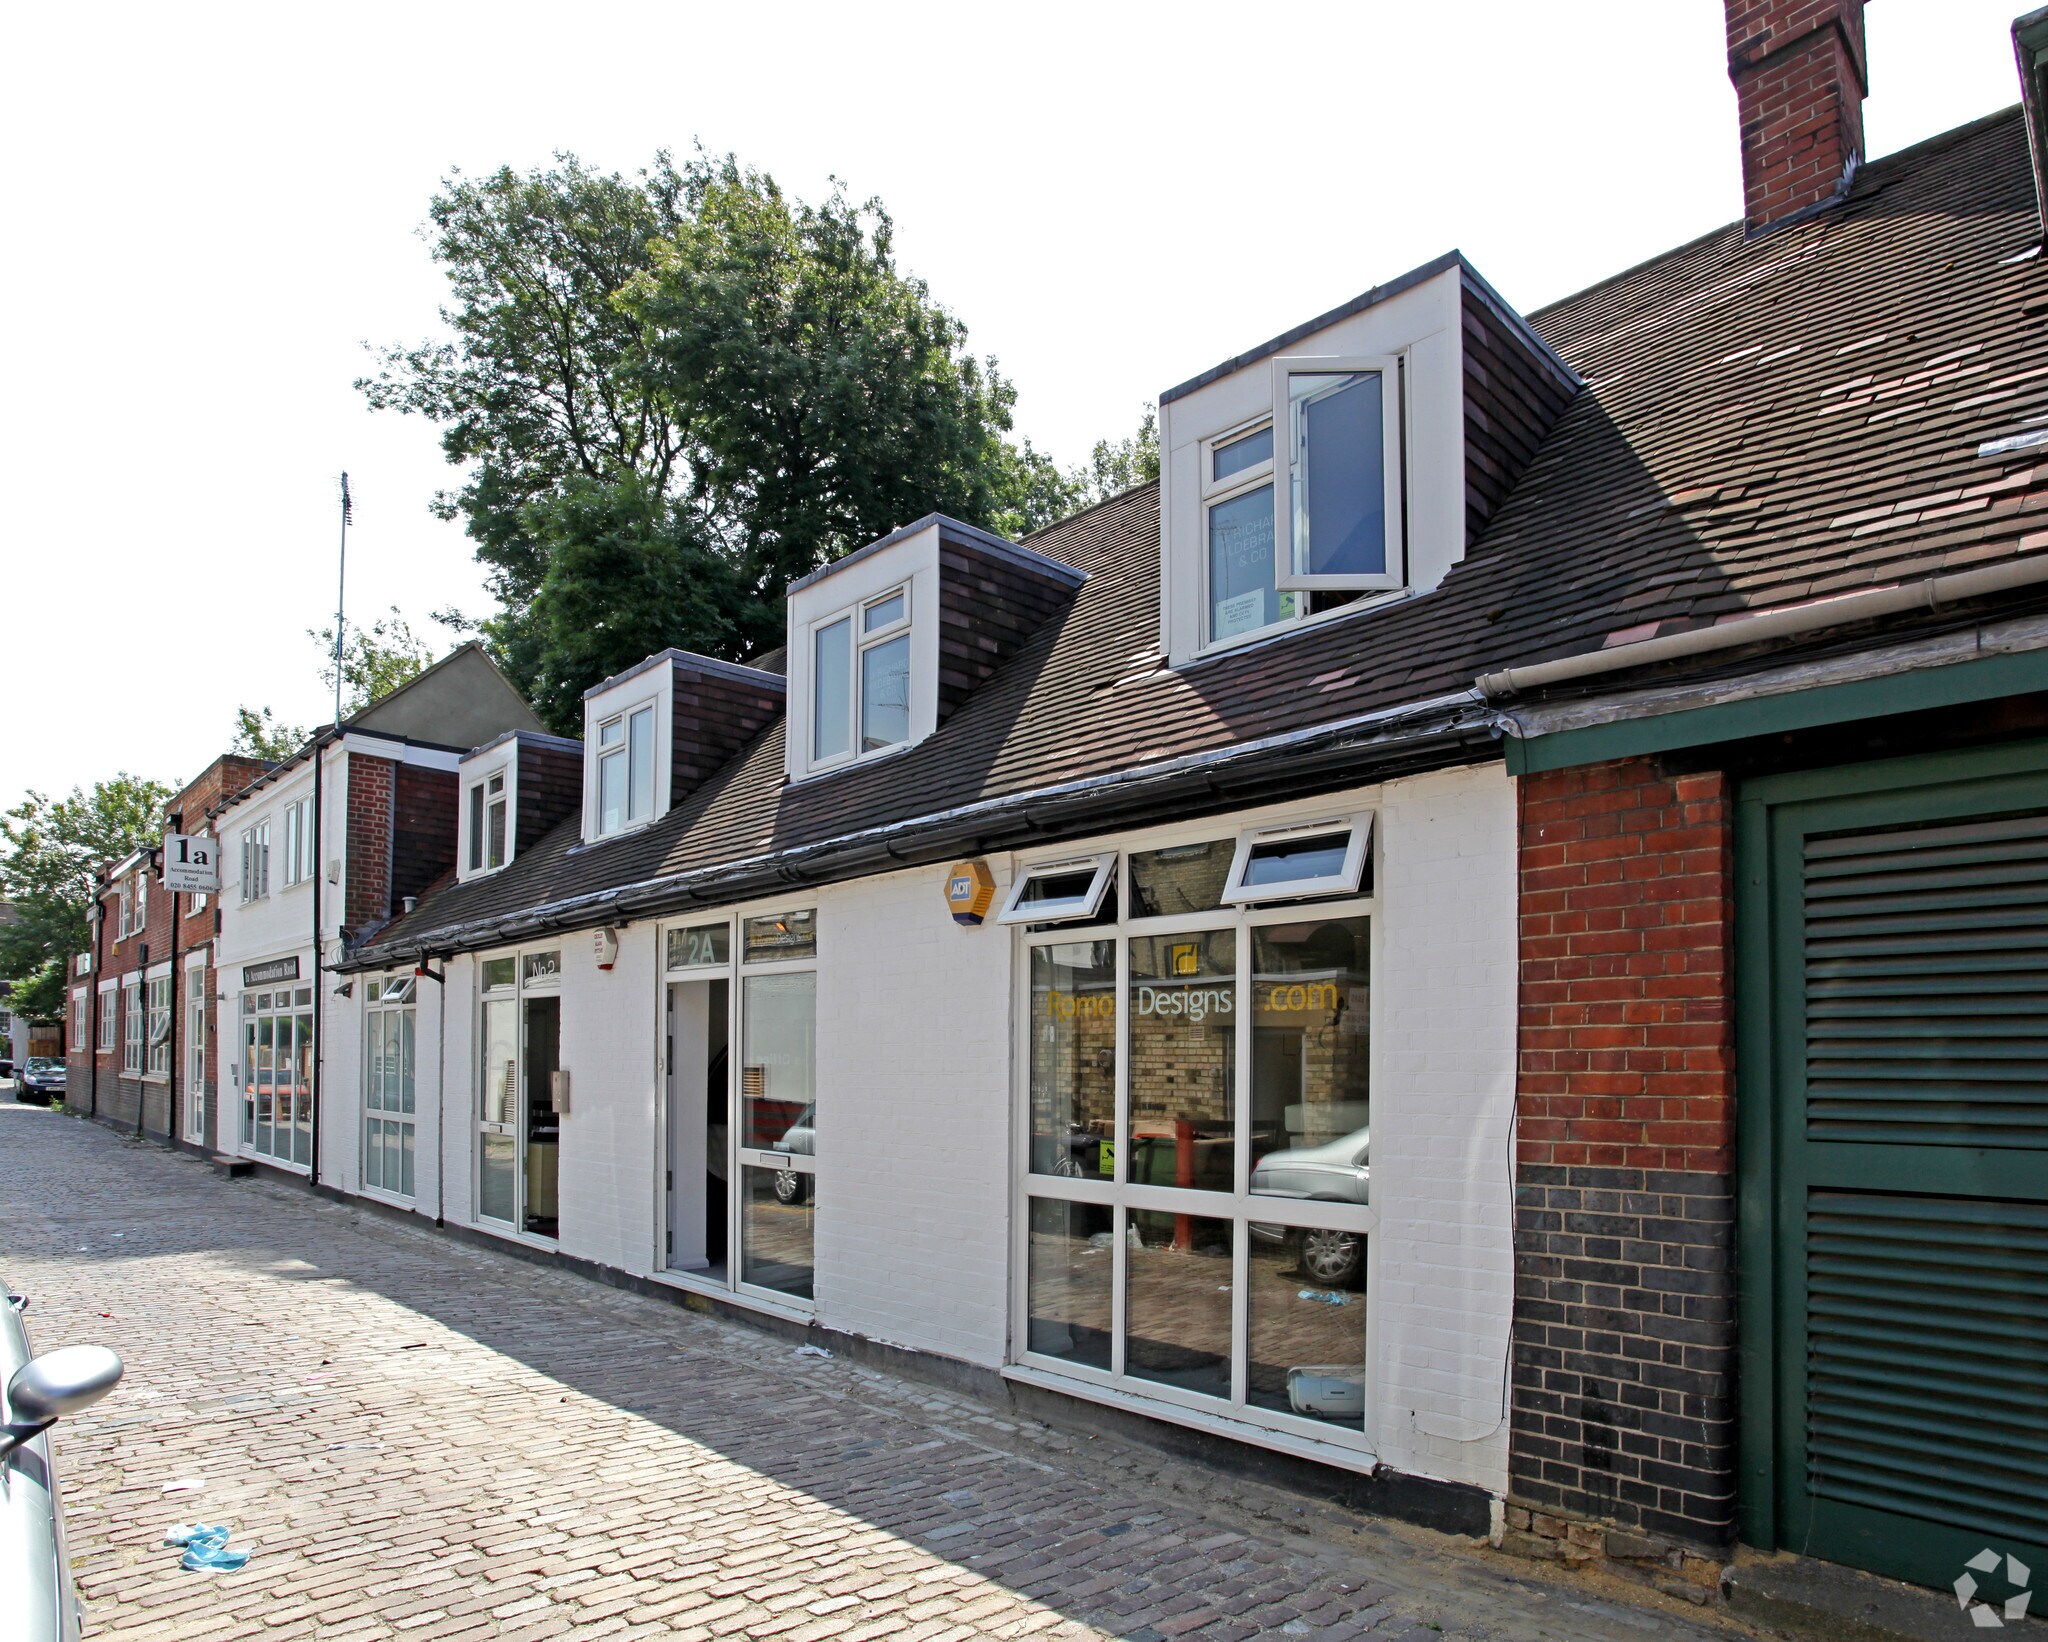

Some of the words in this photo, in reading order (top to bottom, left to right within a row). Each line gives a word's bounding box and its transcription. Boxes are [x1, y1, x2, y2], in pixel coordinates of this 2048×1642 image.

[175, 838, 209, 866] 1a
[171, 867, 213, 875] Accommodation
[952, 881, 971, 896] ADT
[688, 933, 715, 964] 2A
[250, 965, 283, 982] Accommodation
[283, 960, 296, 976] Road
[1047, 991, 1114, 1023] Romo
[1138, 984, 1233, 1022] Designs
[1263, 983, 1339, 1012] .com
